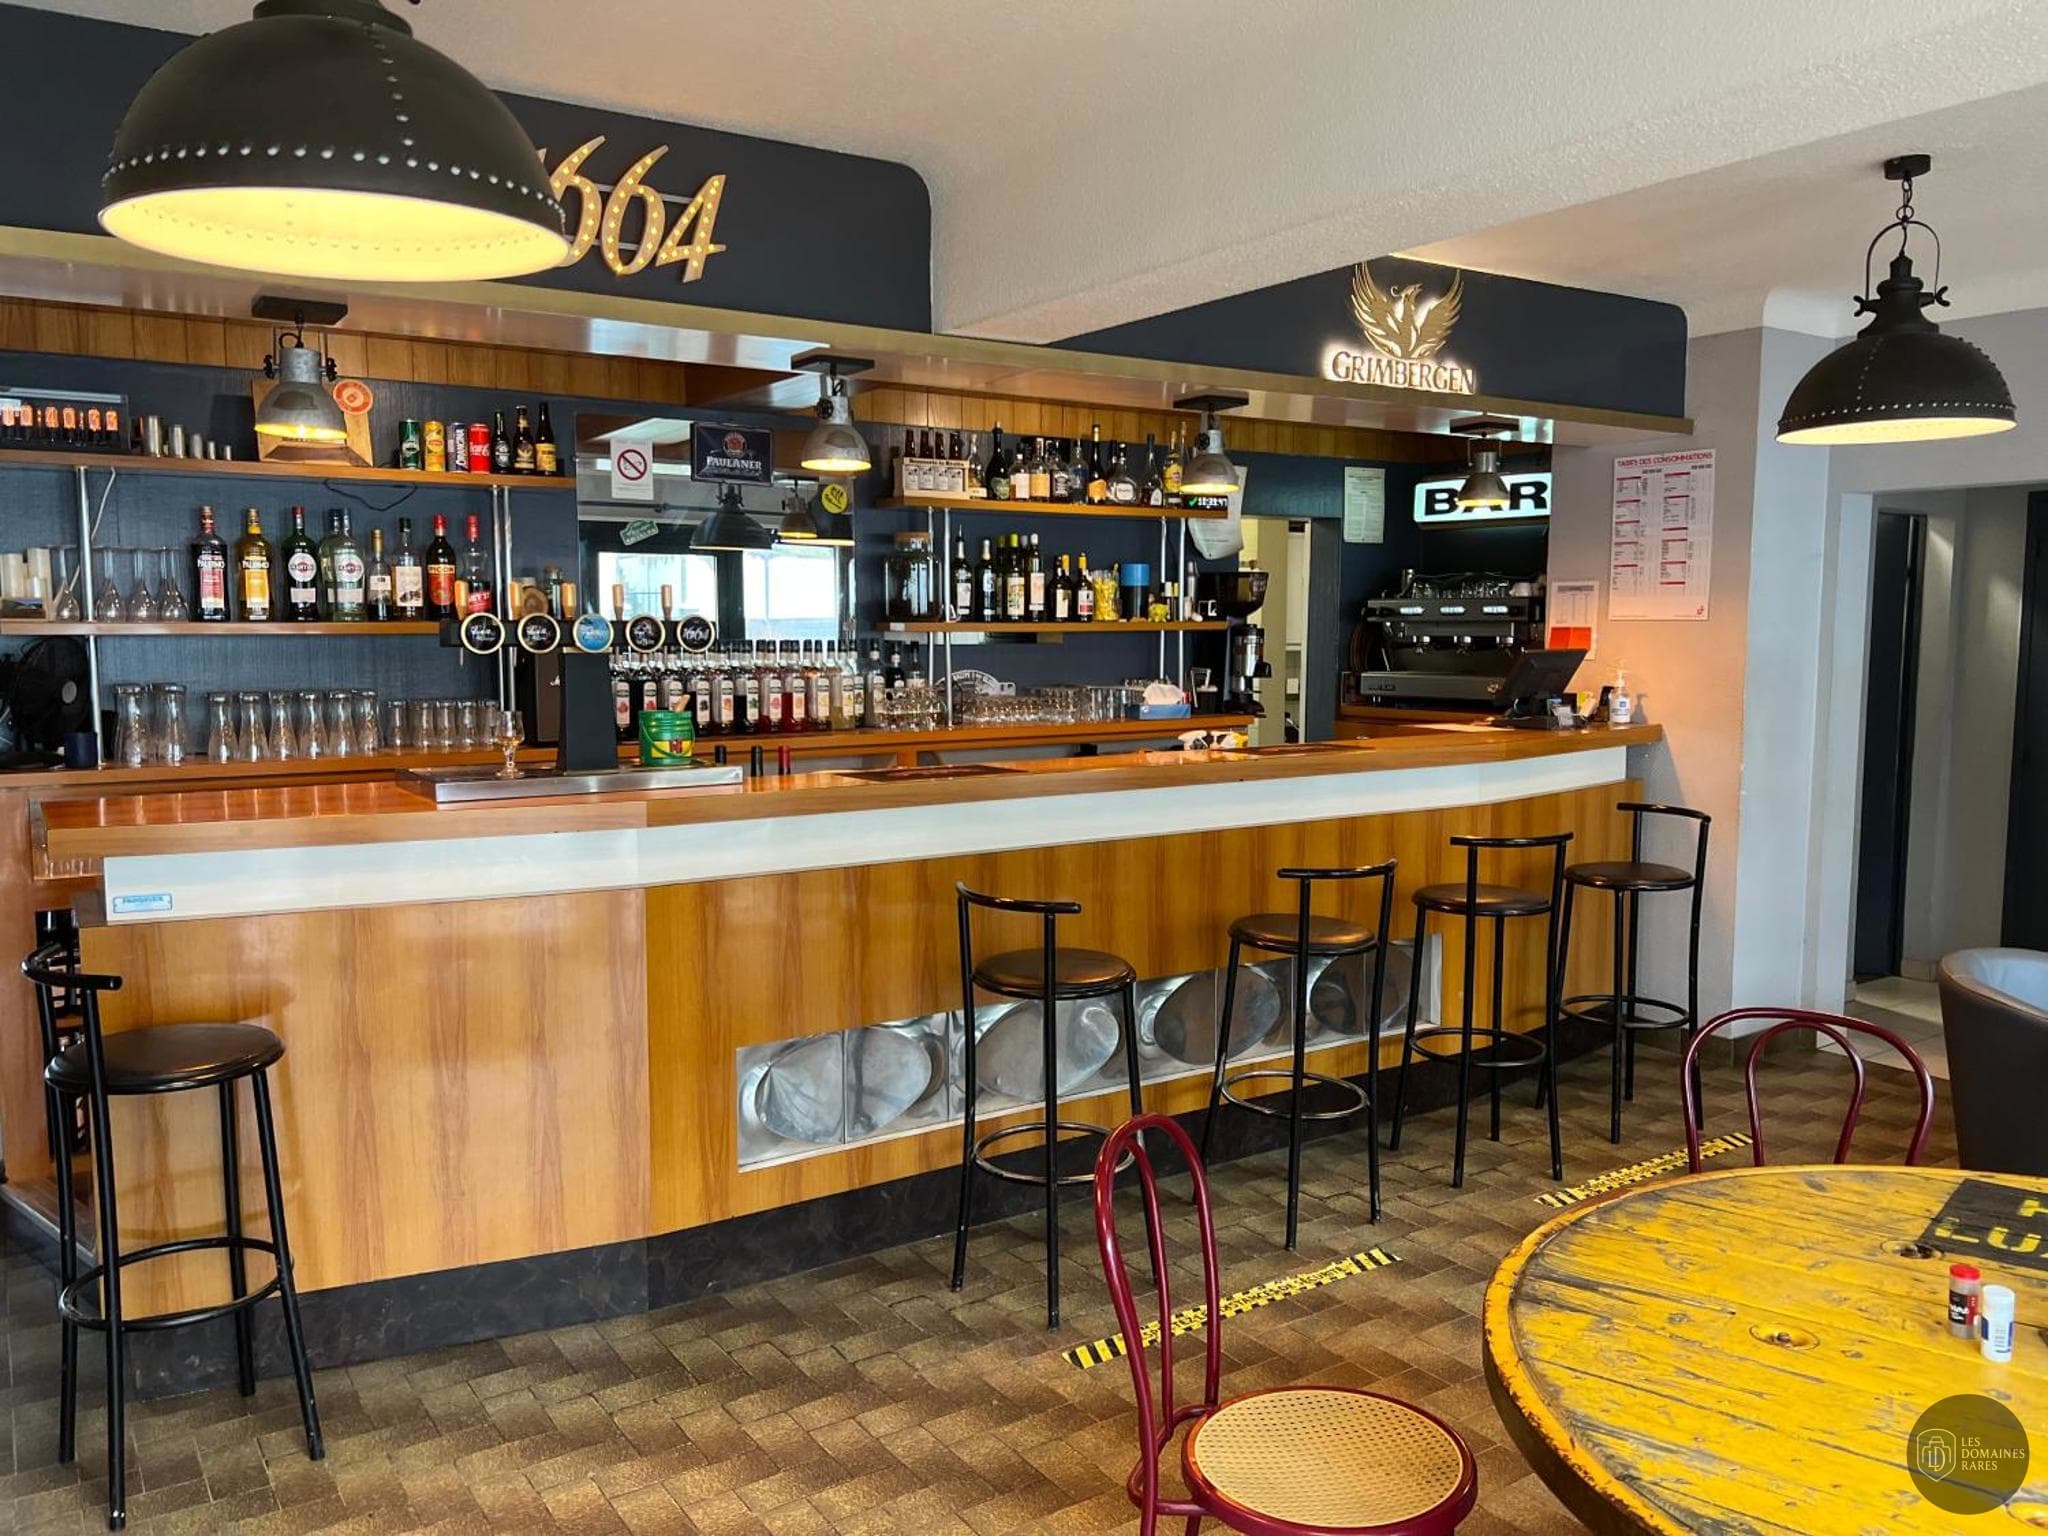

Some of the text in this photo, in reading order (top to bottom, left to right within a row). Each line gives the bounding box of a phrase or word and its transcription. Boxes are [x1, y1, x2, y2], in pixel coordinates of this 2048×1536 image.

[538, 134, 727, 284] 664
[1331, 351, 1475, 394] GRIMBERGEN
[706, 456, 762, 470] PAULANER
[1424, 480, 1549, 516] BR
